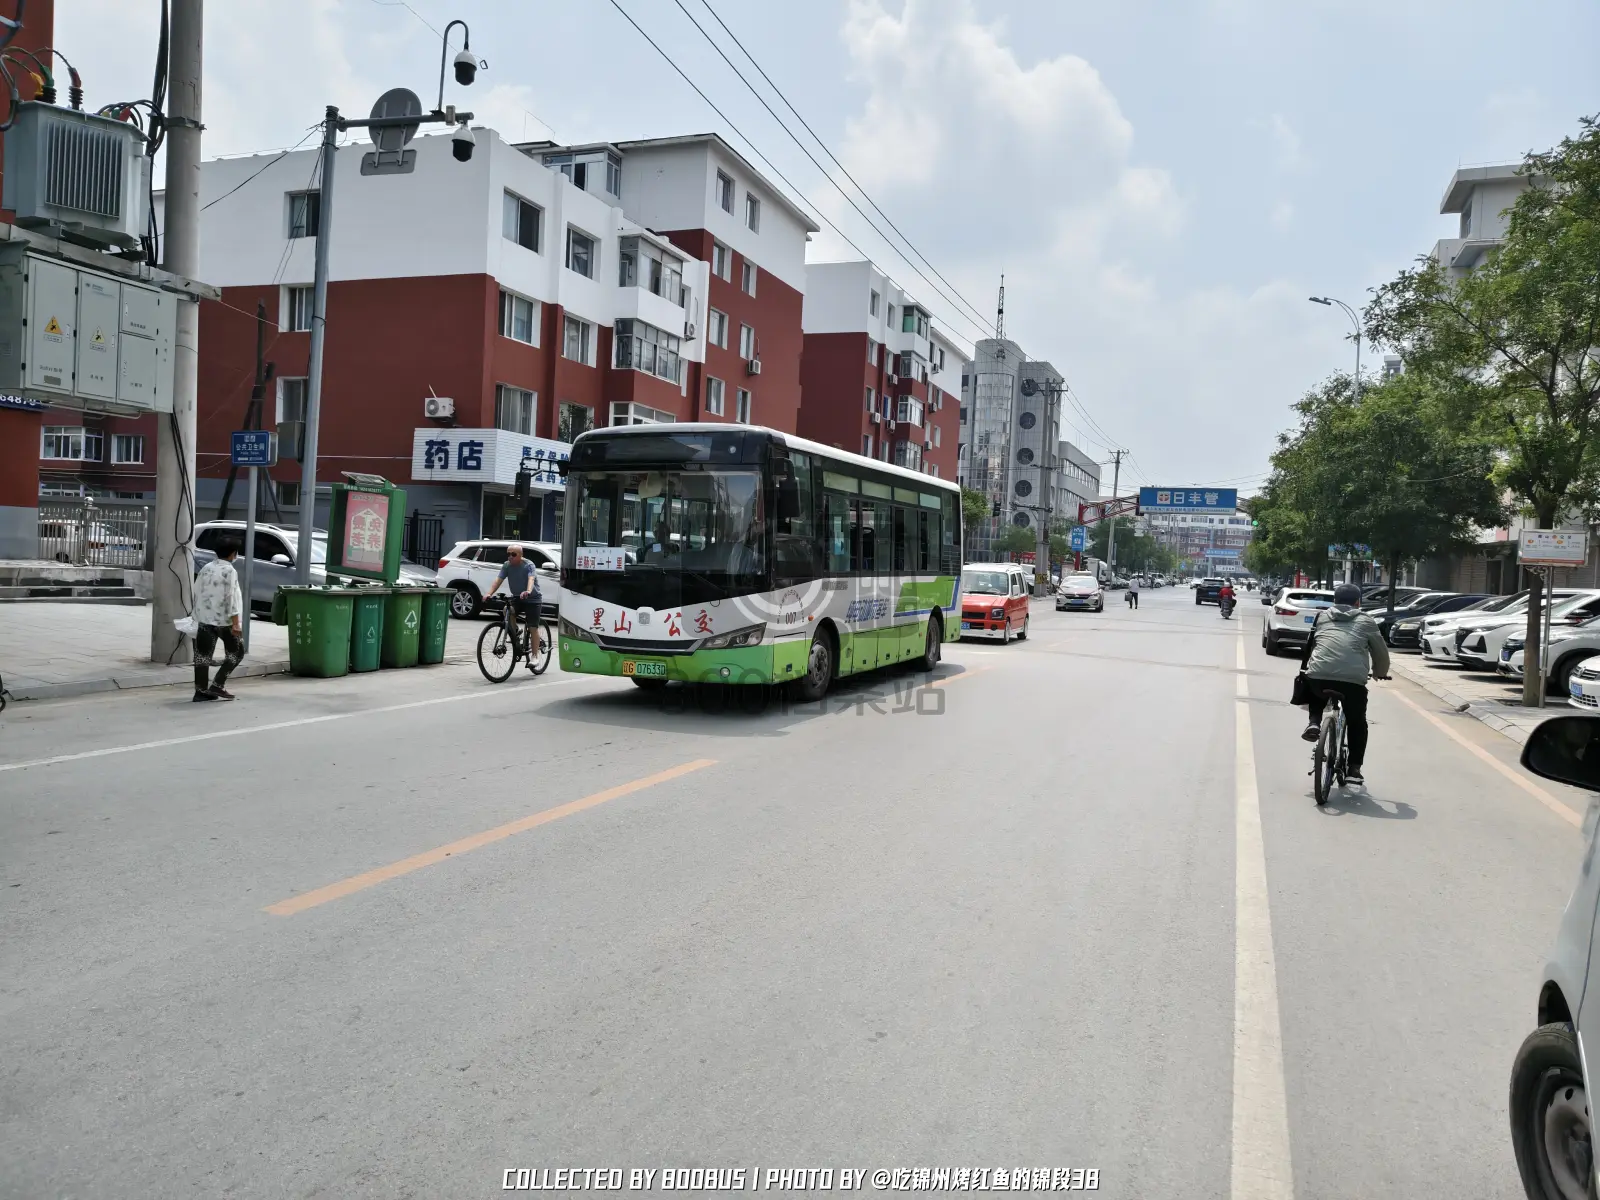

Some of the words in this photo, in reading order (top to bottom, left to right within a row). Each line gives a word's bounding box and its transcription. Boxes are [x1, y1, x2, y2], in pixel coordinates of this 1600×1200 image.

[425, 440, 483, 470] 药店
[1174, 492, 1218, 505] 日丰管
[589, 607, 631, 634] 黑山
[664, 609, 713, 637] 公交
[785, 612, 797, 624] 007
[636, 663, 666, 675] 07633D
